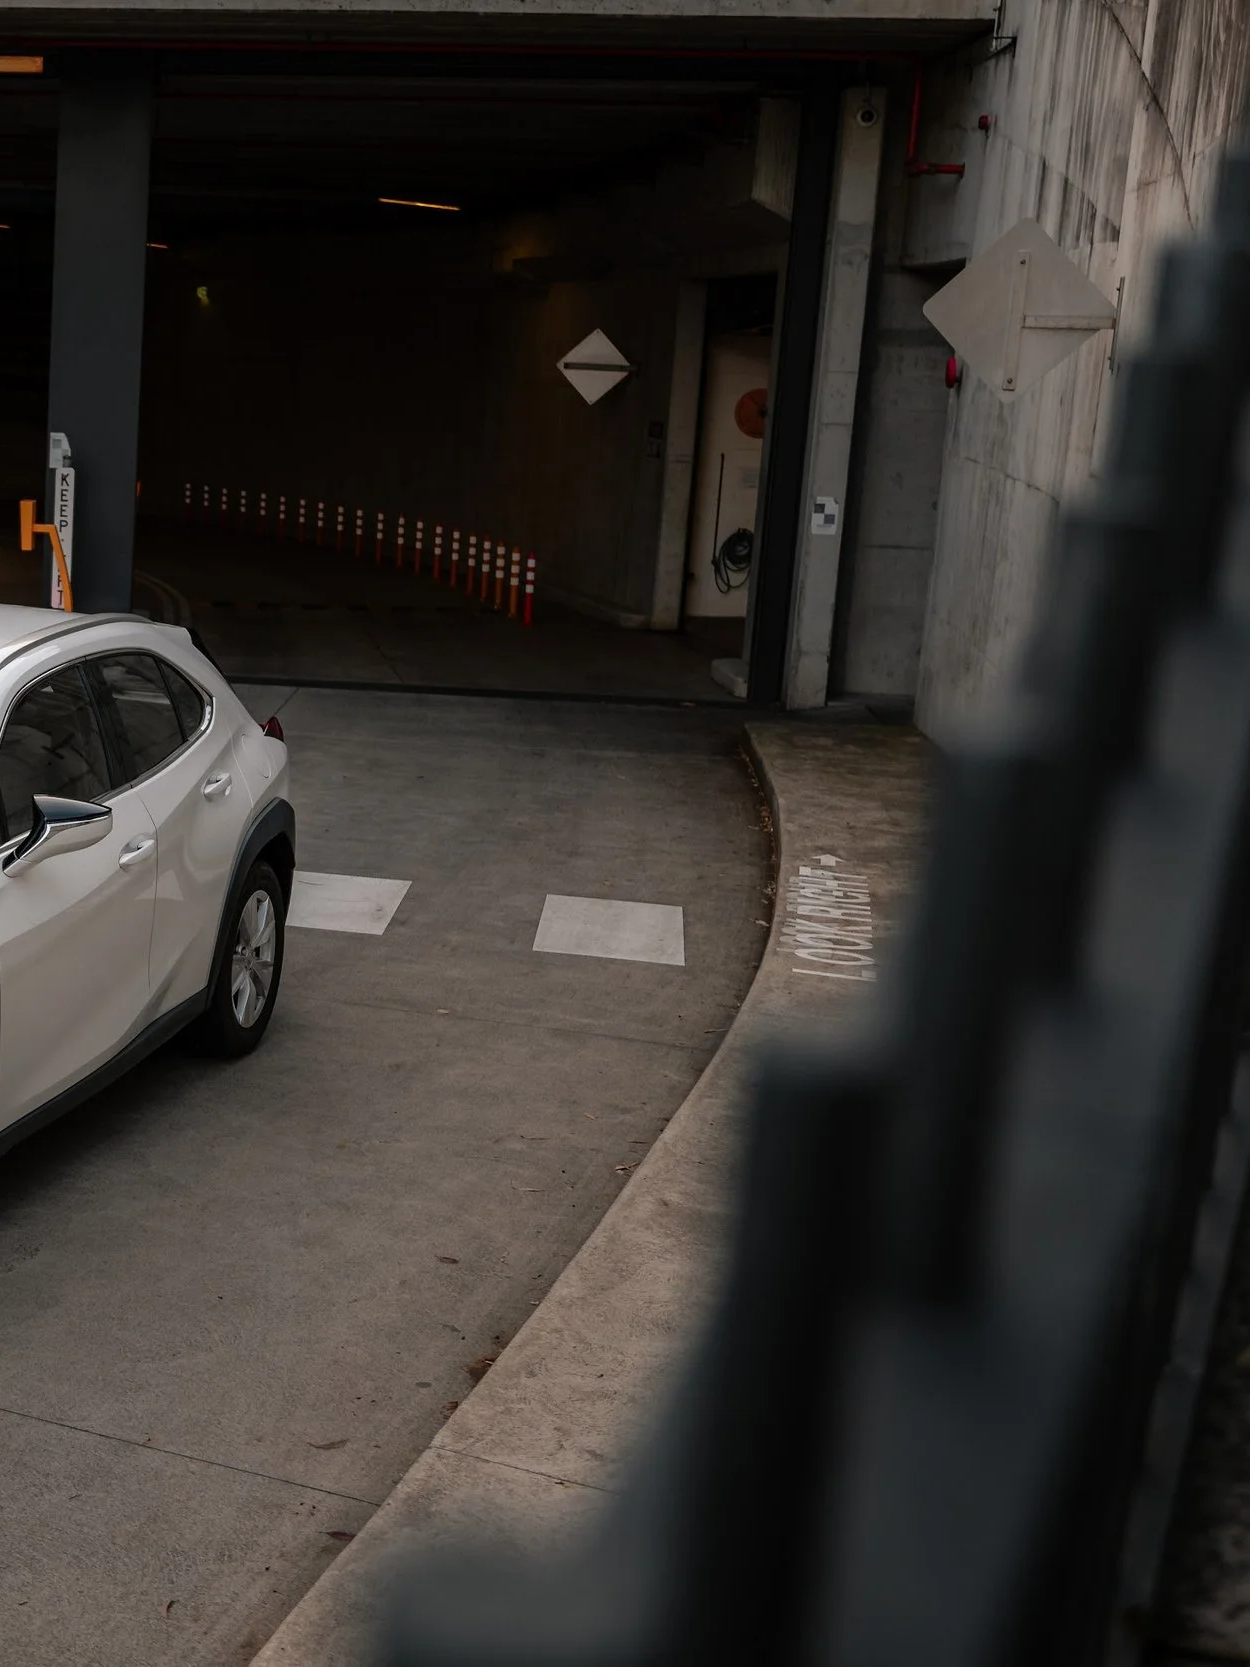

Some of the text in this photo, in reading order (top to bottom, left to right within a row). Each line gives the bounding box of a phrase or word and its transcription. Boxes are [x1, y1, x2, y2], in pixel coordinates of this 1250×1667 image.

[59, 473, 69, 533] KEEP
[792, 866, 878, 982] LOOK RIGHT
